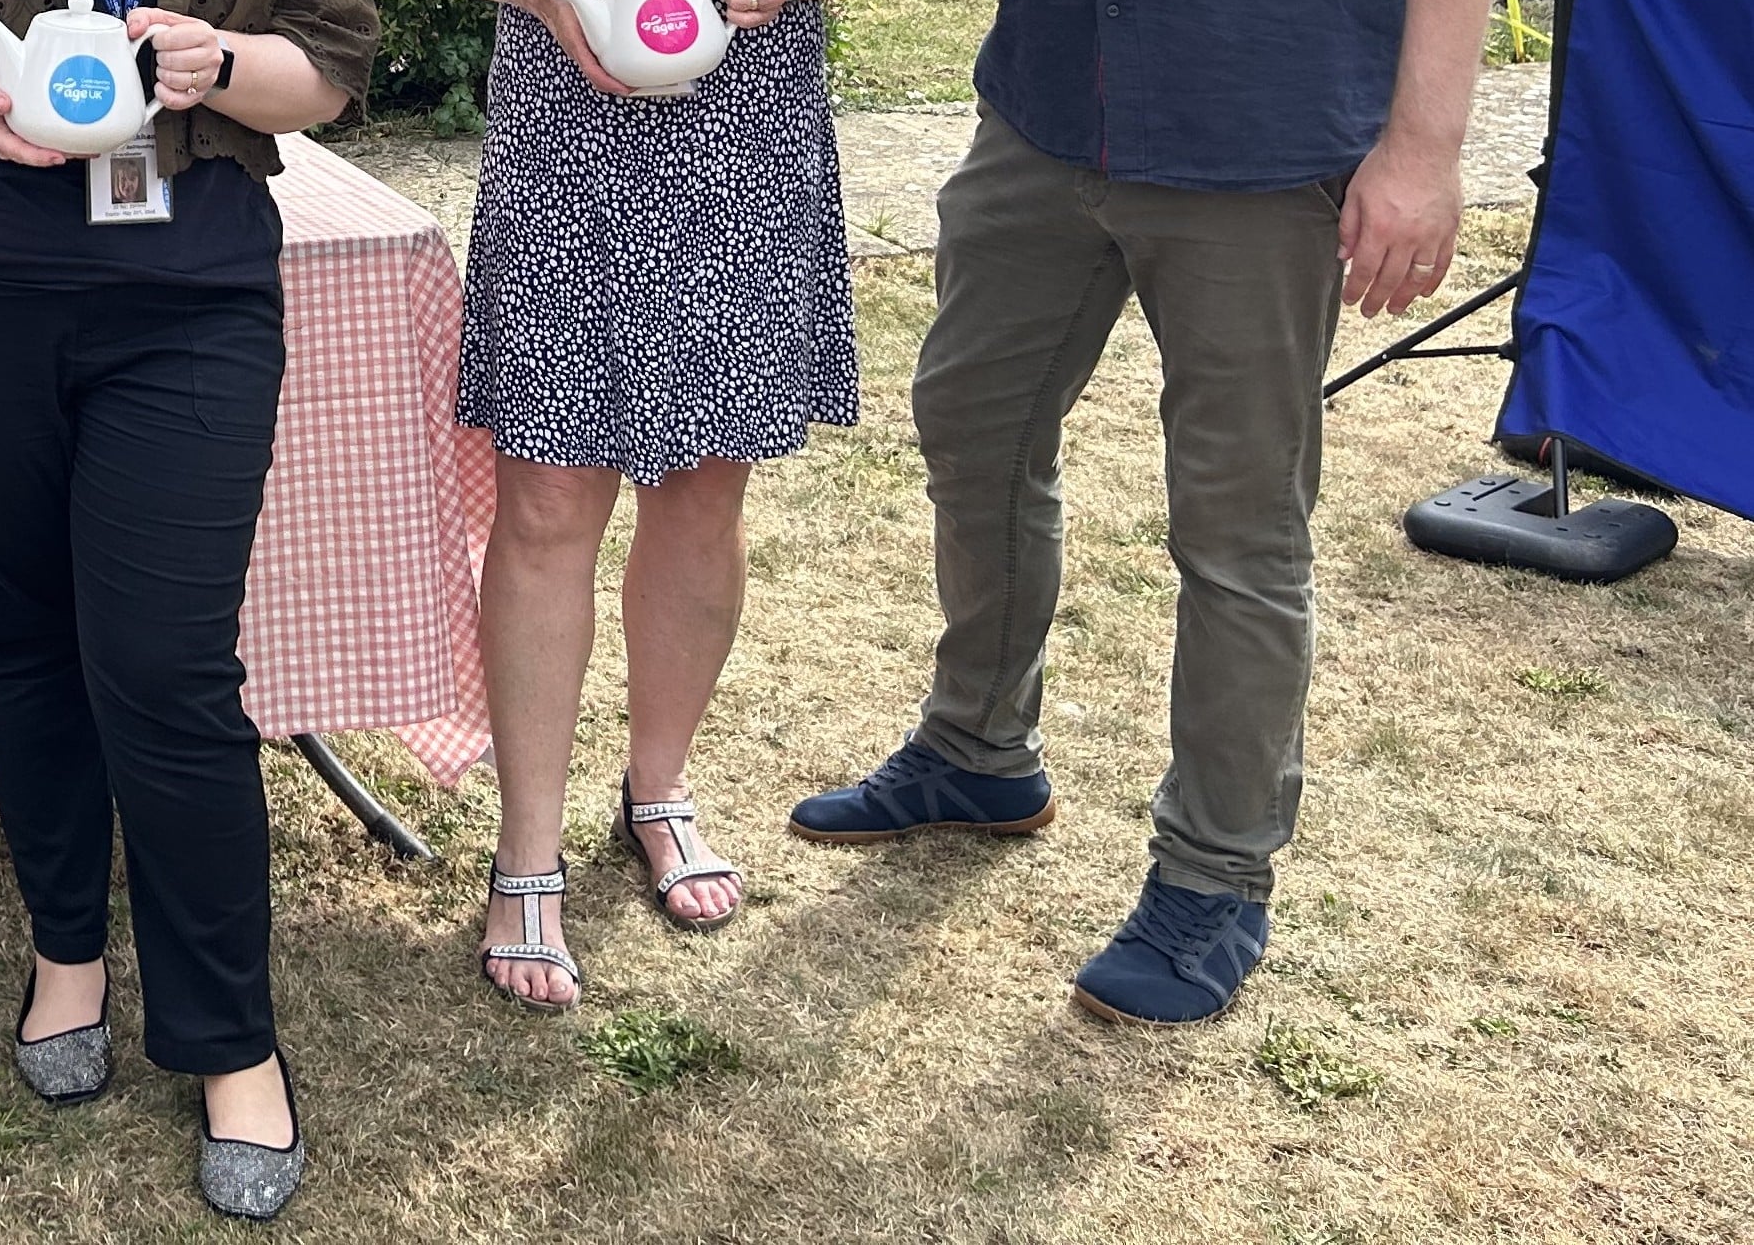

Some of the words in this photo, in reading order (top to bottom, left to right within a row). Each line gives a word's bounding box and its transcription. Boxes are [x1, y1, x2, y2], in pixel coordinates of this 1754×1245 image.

[653, 23, 675, 36] age
[63, 88, 88, 102] age
[88, 90, 103, 100] UK
